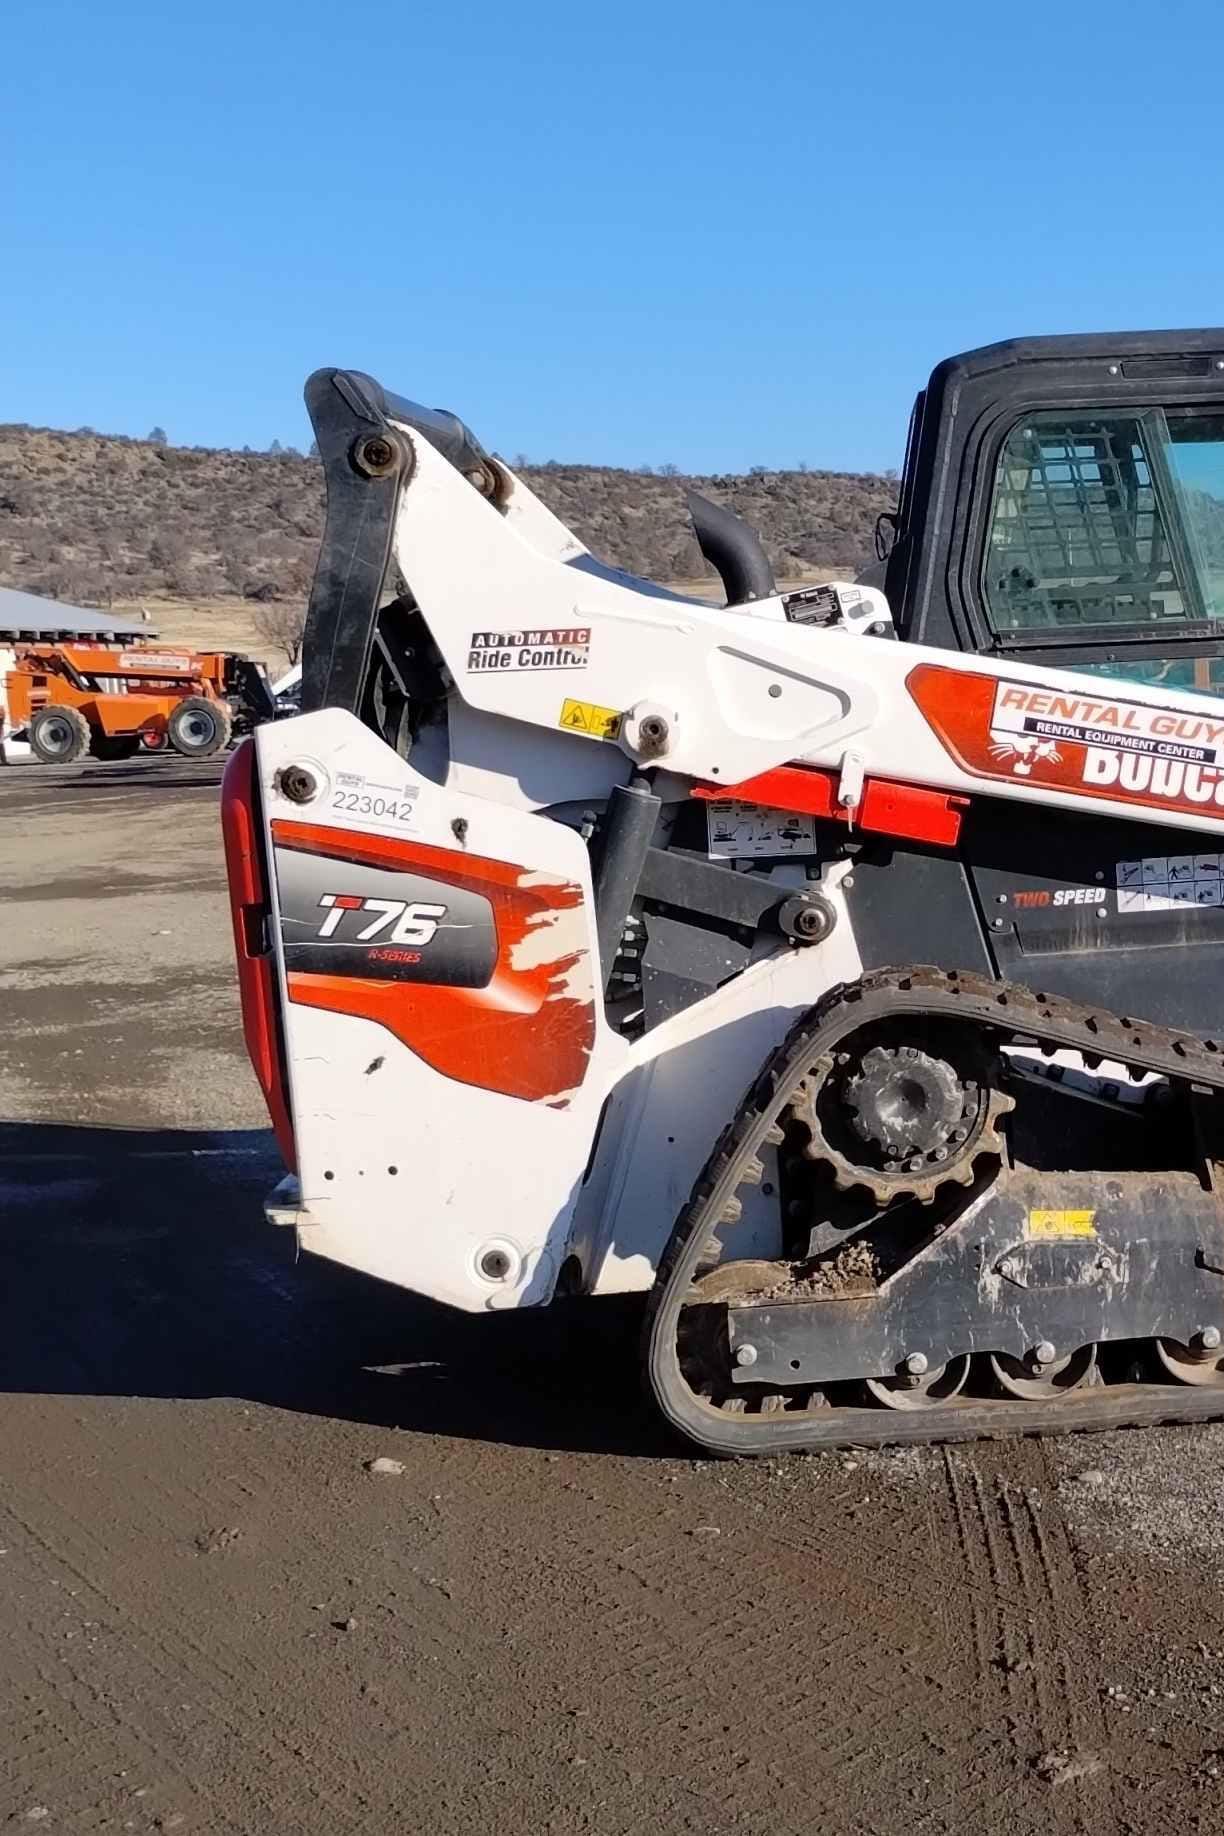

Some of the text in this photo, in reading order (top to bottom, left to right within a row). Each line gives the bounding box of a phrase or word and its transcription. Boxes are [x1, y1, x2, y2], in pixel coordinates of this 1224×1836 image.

[475, 630, 588, 648] AUTOMATIC
[468, 650, 511, 669] Ride
[1000, 688, 1141, 730] RENTAL
[1036, 721, 1205, 760] RENTAL EQUIPMENT CENTER
[332, 791, 412, 821] 223042
[1014, 888, 1106, 907] TWO SPEED
[317, 893, 448, 947] T76
